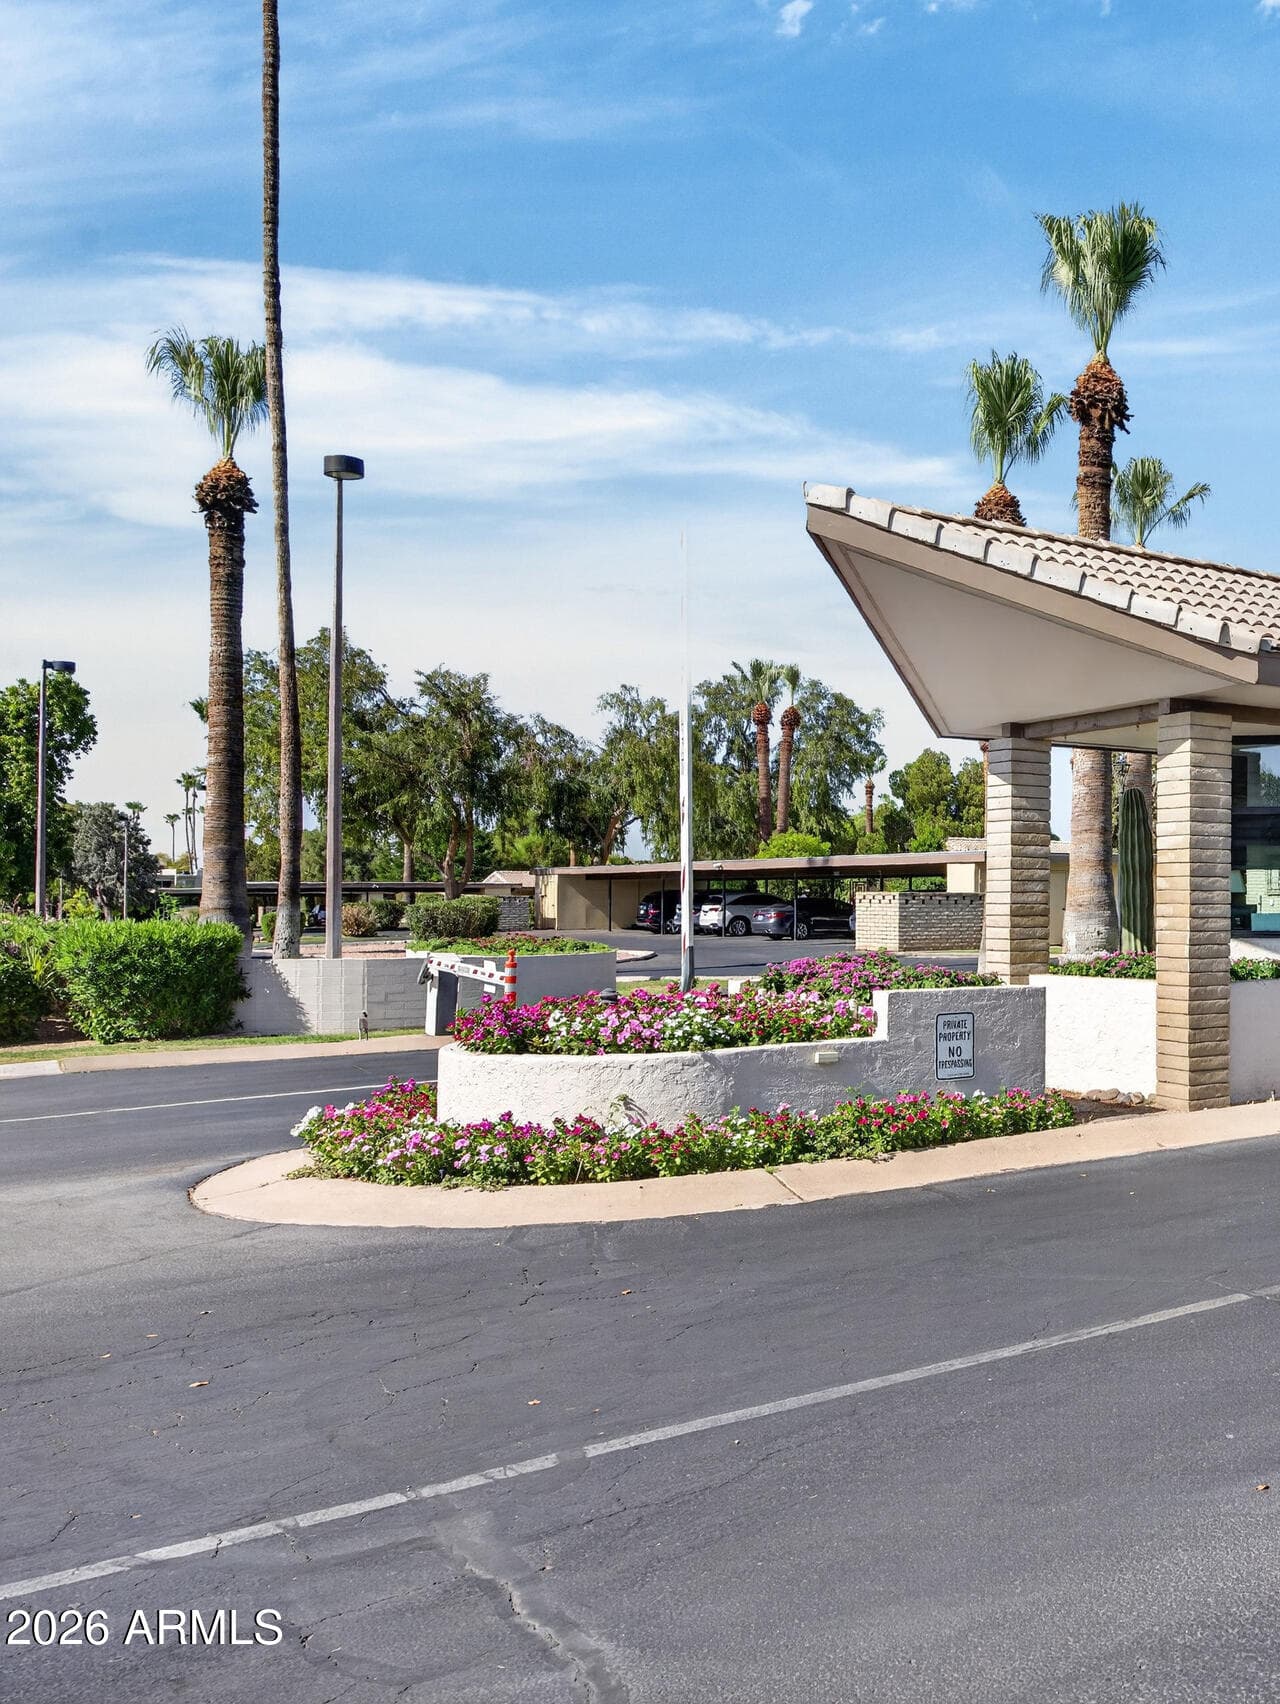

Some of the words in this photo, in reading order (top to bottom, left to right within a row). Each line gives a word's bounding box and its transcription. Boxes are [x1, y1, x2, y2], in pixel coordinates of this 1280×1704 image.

[943, 1020, 967, 1030] PRIVATE
[939, 1031, 971, 1042] PROPERTY
[948, 1046, 962, 1057] NO
[939, 1059, 972, 1069] TRESPASSING
